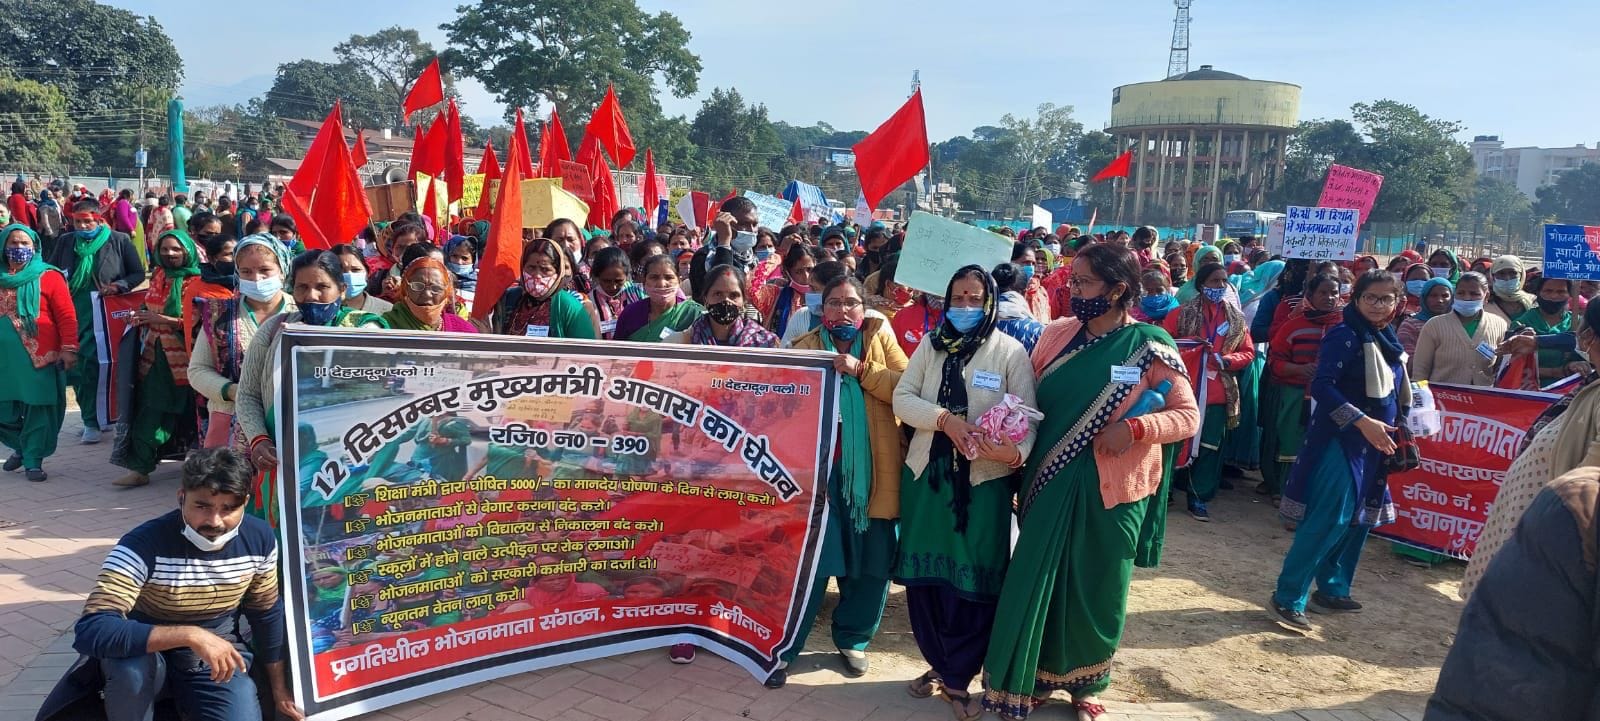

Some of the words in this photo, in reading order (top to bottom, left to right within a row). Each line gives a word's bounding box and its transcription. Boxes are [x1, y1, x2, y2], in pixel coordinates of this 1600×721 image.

[331, 366, 387, 380] देहरादून
[389, 365, 418, 377] चलो
[725, 380, 769, 396] देहरादून
[772, 382, 796, 394] चलो
[314, 459, 348, 498] 12
[343, 386, 461, 465] दिसम्बर
[467, 366, 601, 412] मुख्यमंत्री
[607, 378, 701, 426] आवास
[702, 407, 743, 450] का
[743, 436, 800, 501] घेराव
[614, 436, 648, 452] 390
[375, 483, 408, 504] शिक्षा
[411, 480, 438, 498] मंत्री
[440, 481, 466, 498] द्वारा
[470, 475, 507, 493] घोषित
[554, 479, 572, 490] का
[574, 477, 618, 492] मानदेय
[621, 477, 658, 493] घोषणा
[660, 480, 674, 495] के
[677, 481, 700, 497] दिन
[703, 483, 715, 498] से
[718, 487, 746, 506] लागू
[747, 491, 776, 506] करो।
[375, 501, 463, 526] भोजनमाताओं
[465, 502, 478, 517] से
[480, 500, 514, 517] बेगार
[517, 499, 555, 515] कराना
[558, 499, 577, 512] बंद
[580, 499, 611, 512] करो।
[376, 524, 464, 552] भोजनमाताओं
[466, 525, 484, 540] को
[487, 520, 537, 539] विद्यालय
[538, 518, 550, 534] से
[554, 519, 610, 532] निकालना
[613, 520, 631, 531] बंद
[635, 521, 664, 533] करो।
[378, 555, 419, 579] स्कूलों
[419, 552, 434, 570] में
[435, 550, 459, 569] होने
[463, 545, 488, 563] वाले
[541, 542, 559, 555] पर
[561, 538, 584, 553] रोक
[587, 538, 635, 552] लगाओ।
[379, 573, 465, 602] भोजनमाताओं
[470, 570, 489, 586] को
[491, 562, 538, 583] सरकारी
[540, 558, 587, 577] कर्मचारी
[590, 561, 607, 572] का
[610, 556, 636, 571] दर्जा
[638, 558, 657, 571] दो।
[381, 606, 430, 630] न्यूनतम
[432, 598, 463, 616] वेतन
[465, 595, 496, 613] लागू
[496, 586, 526, 605] करो।
[330, 634, 431, 682] प्रगतिशील
[434, 614, 536, 652] भोजनमाता
[539, 604, 606, 632] संगठन,
[709, 600, 773, 641] नैनीताल
